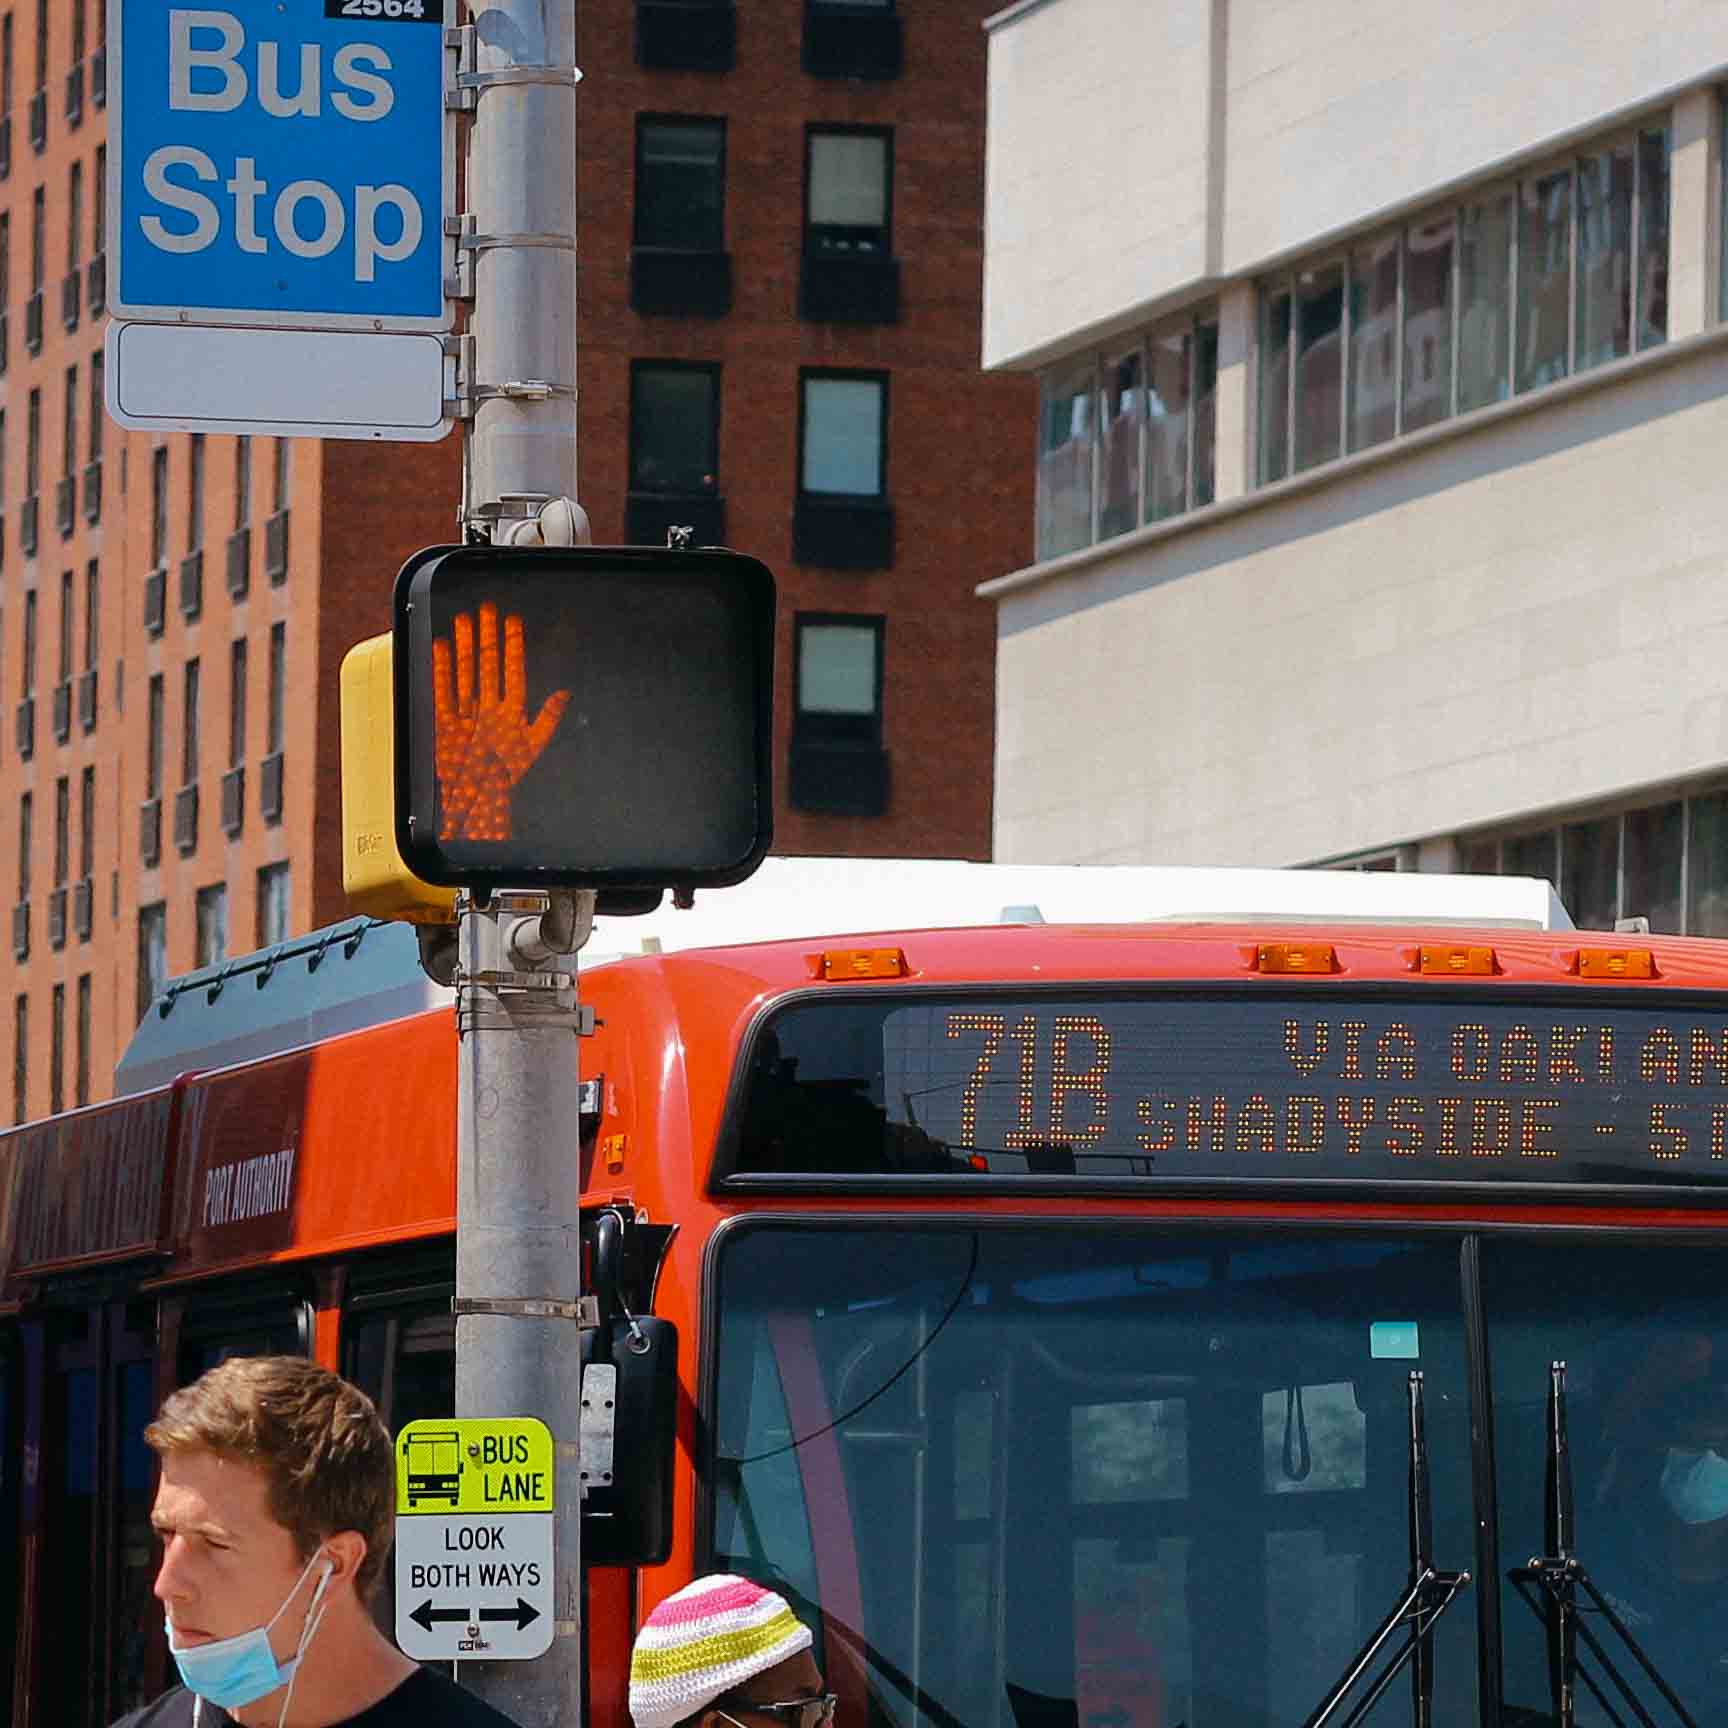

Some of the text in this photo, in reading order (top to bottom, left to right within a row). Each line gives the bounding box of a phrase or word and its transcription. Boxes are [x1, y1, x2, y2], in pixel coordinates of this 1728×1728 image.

[341, 0, 425, 18] 2564
[168, 9, 394, 122] Bus
[139, 145, 423, 282] Stop
[945, 1014, 1113, 1152] 71B
[1283, 1018, 1417, 1082] VIA
[1135, 1093, 1561, 1158] SHADYSIDE
[201, 1146, 296, 1227] PORT AUTHORITY
[482, 1435, 529, 1465] BUS
[483, 1472, 545, 1502] LANE
[445, 1527, 505, 1551] LOOK
[411, 1562, 541, 1588] BOTH WAYS
